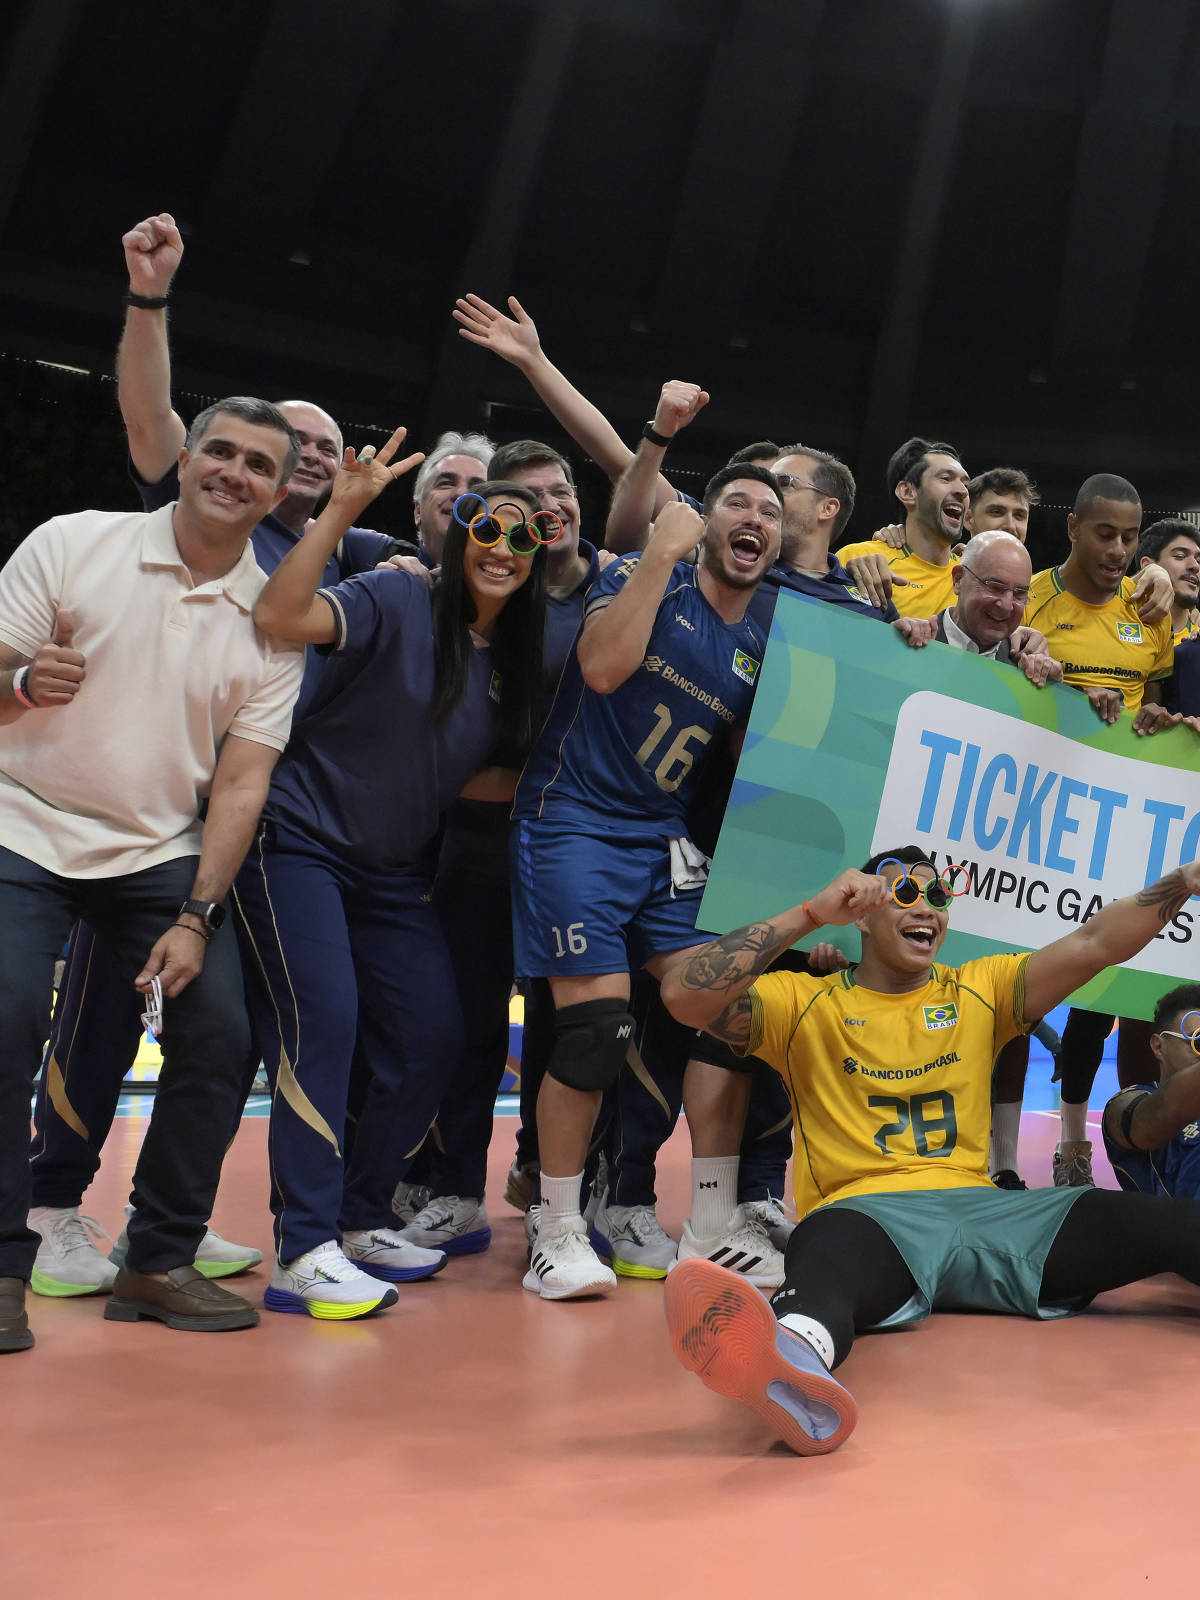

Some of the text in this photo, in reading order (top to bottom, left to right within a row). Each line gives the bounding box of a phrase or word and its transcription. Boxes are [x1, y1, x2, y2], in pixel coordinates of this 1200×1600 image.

[675, 612, 696, 632] VOLT
[1064, 662, 1100, 674] BANCO
[661, 665, 736, 722] BANCO DO BRAS
[635, 703, 713, 793] 16
[915, 729, 1128, 881] TICKET
[929, 850, 1050, 914] YMPIC
[552, 922, 588, 958] 16
[927, 1020, 958, 1030] BRASIL
[861, 1051, 962, 1080] BANCO DO BRASIL
[868, 1090, 958, 1158] 28
